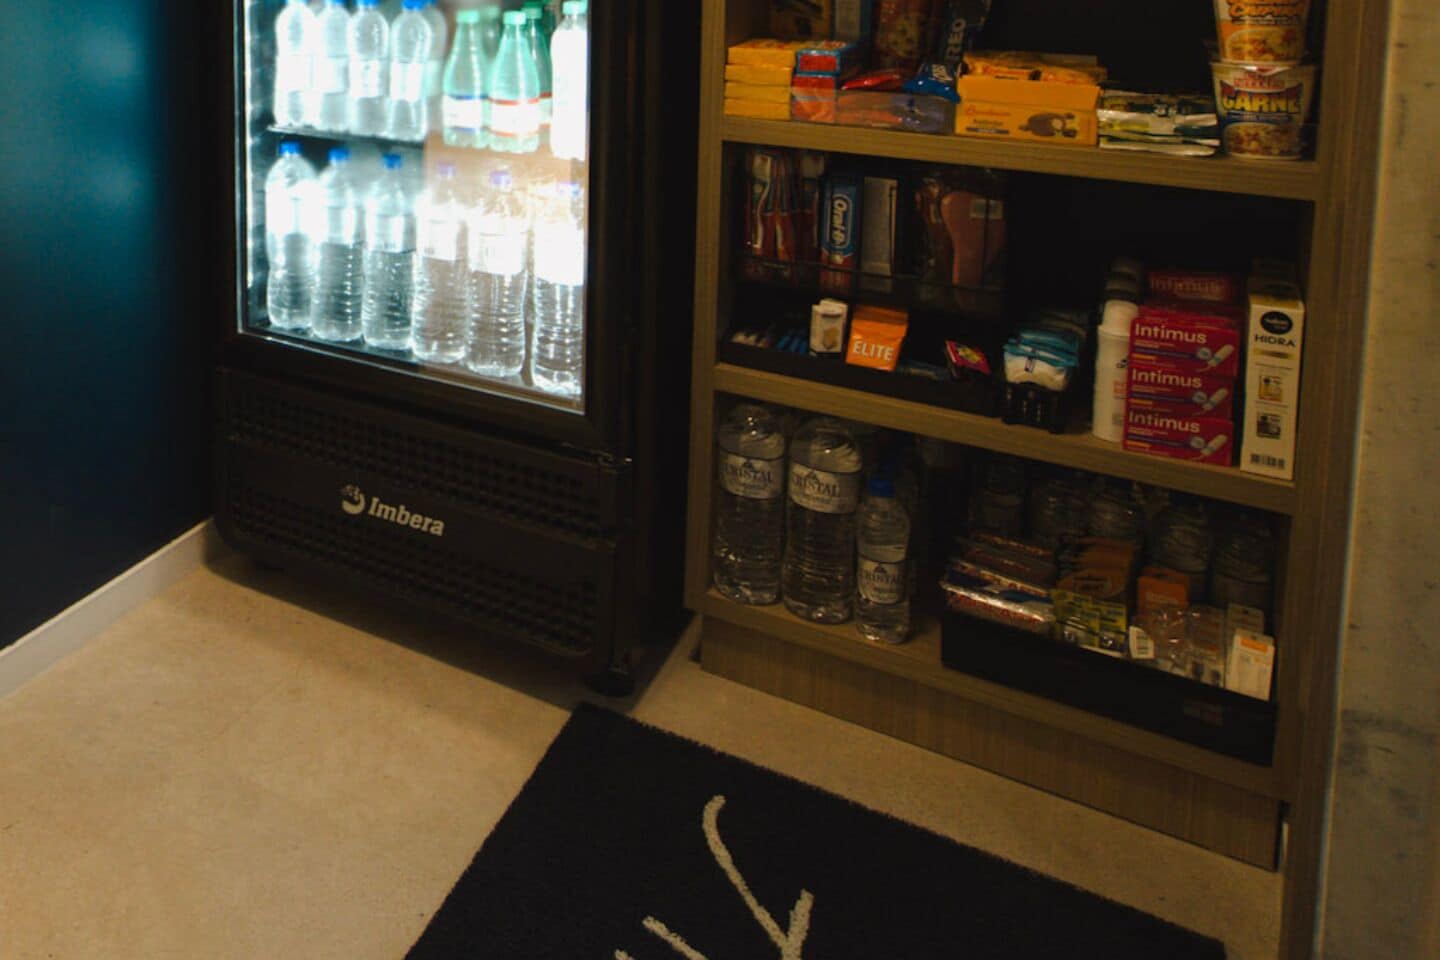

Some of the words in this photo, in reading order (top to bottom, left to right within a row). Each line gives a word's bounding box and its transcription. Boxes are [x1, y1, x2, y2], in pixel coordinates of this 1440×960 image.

[1135, 322, 1207, 345] Intimus
[852, 340, 894, 361] ELITE
[1131, 368, 1202, 389] Intimus
[1128, 409, 1200, 434] Intimus
[367, 496, 445, 537] Imbera
